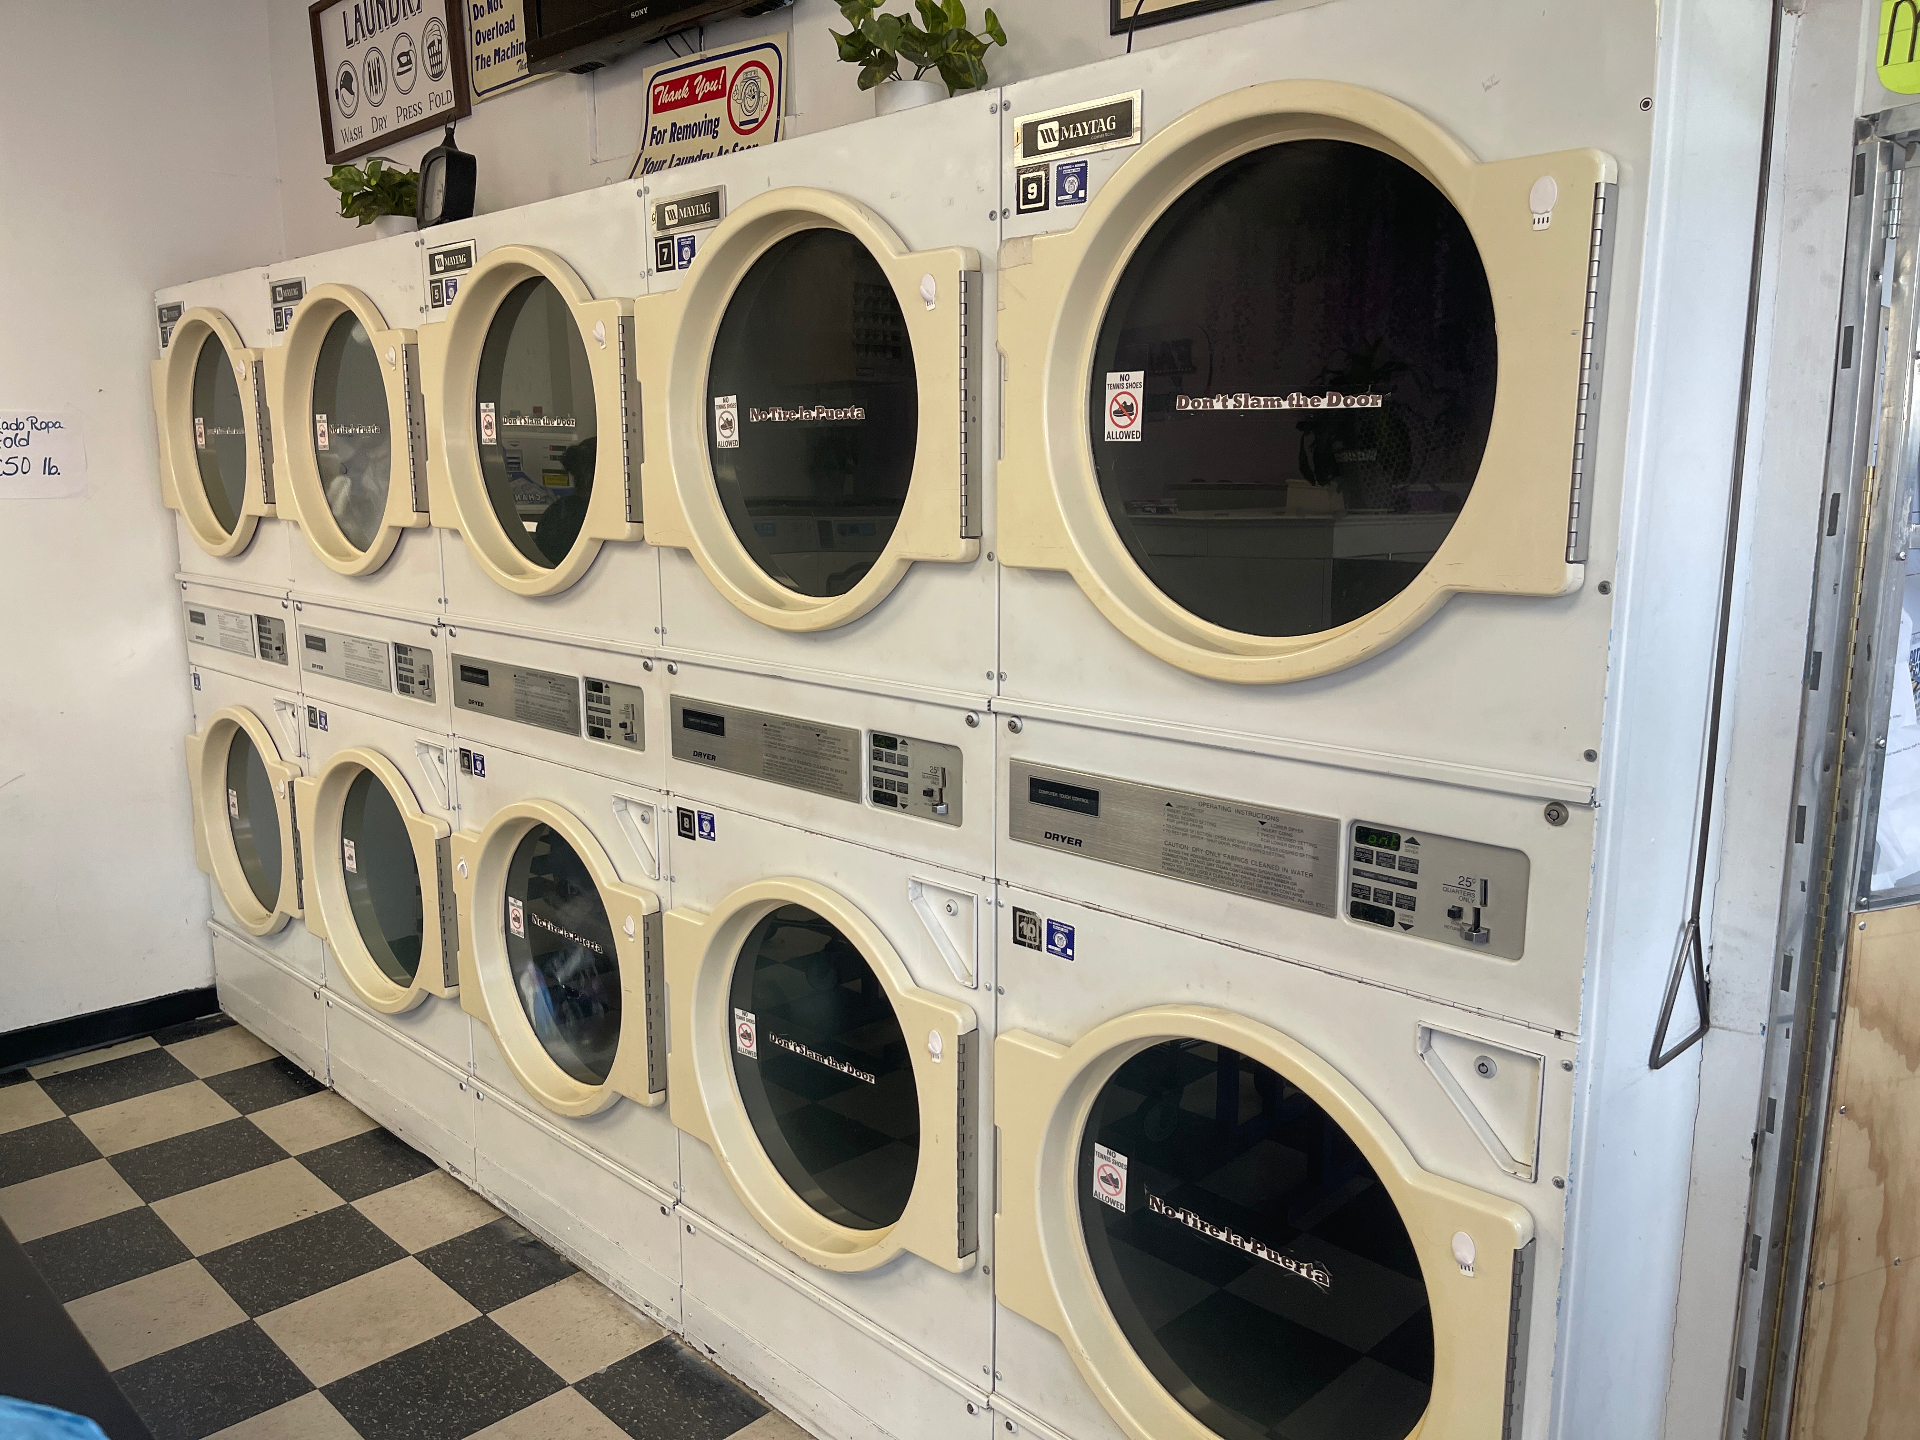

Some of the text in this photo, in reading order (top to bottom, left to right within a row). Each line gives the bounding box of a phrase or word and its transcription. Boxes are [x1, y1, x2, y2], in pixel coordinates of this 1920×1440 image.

[473, 4, 484, 21] Do
[630, 7, 648, 19] SONY
[342, 0, 423, 49] LAUND
[475, 14, 515, 46] Overload
[475, 38, 527, 71] The Machin
[654, 69, 725, 106] Thank You!
[340, 90, 452, 144] WASH DRY PRESS FOLD
[649, 113, 720, 146] For Removing
[1060, 115, 1116, 141] MAYTAG
[1027, 183, 1038, 200] 9
[679, 202, 711, 219] MAYTAG
[444, 254, 466, 266] MAYTAG
[662, 248, 668, 261] 7
[435, 289, 439, 299] 5
[1107, 381, 1143, 390] TENNIS SHOES
[1119, 374, 1130, 382] NO
[1176, 391, 1382, 410] Don't Slam the Door
[503, 416, 523, 426] Don't
[524, 416, 542, 426] Slam
[556, 416, 576, 427] Door
[750, 405, 865, 422] No Tire la Puerta
[26, 416, 64, 434] Ropa
[1106, 430, 1141, 440] ALLOWED
[718, 440, 738, 448] ALLOWED
[0, 456, 61, 476] 50 lb.
[468, 698, 484, 707] DRYER
[692, 750, 716, 761] DRYER
[1038, 788, 1089, 804] COMPUTER TOUCH CONTROL
[1198, 801, 1279, 822] OPERATING INSTRUCTIONS
[684, 817, 689, 828] 8
[1044, 831, 1082, 847] DRYER
[1191, 846, 1203, 854] DRY
[1205, 849, 1220, 858] ONLY
[1222, 853, 1248, 864] FABRICS
[1250, 859, 1279, 871] CLEANED
[1290, 868, 1313, 879] WATER
[1443, 887, 1476, 898] QUARTERS
[1459, 896, 1475, 904] ONLY
[532, 913, 544, 927] No
[1020, 921, 1036, 937] 10
[738, 1046, 757, 1058] ALLOWED
[770, 1032, 875, 1082] Don't Slam the Door
[1095, 1151, 1128, 1170] TENNIS SHOES
[1106, 1149, 1117, 1158] NO
[1093, 1190, 1125, 1211] ALLOWED
[1149, 1196, 1330, 1286] No Tire la Puerta
